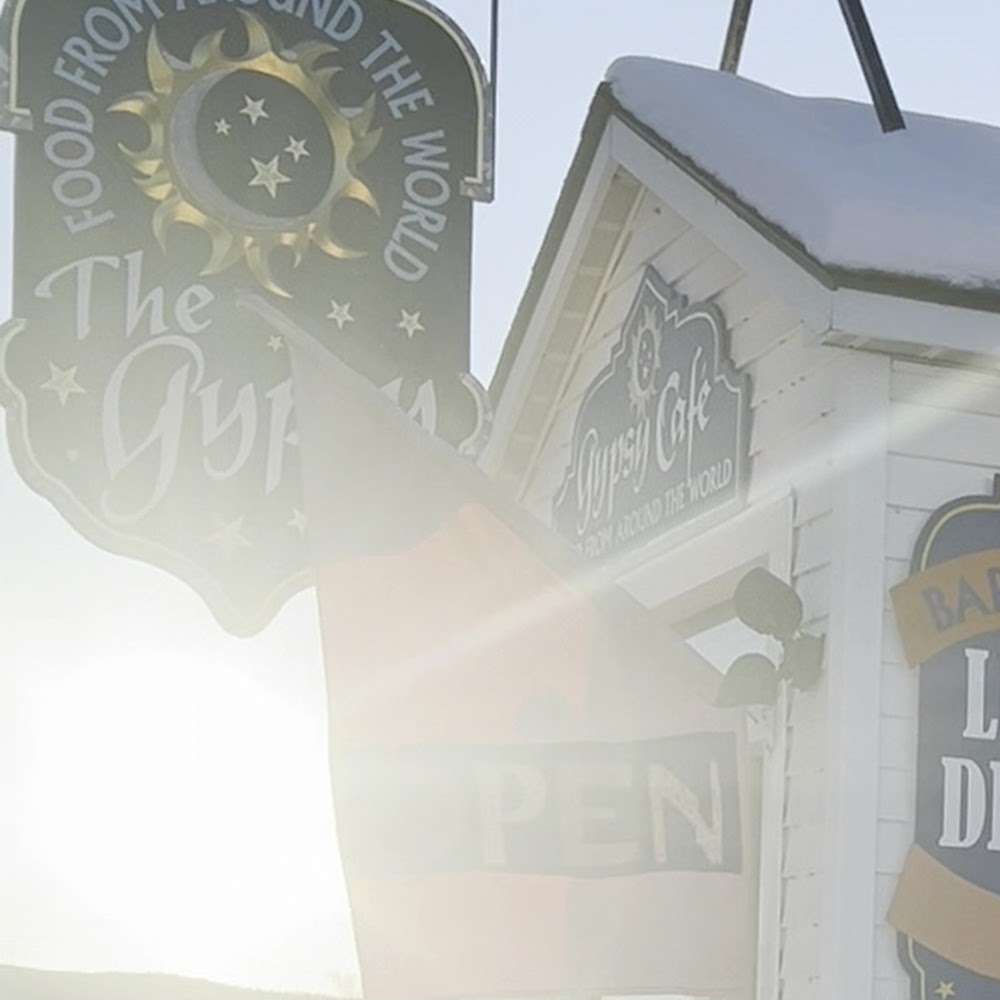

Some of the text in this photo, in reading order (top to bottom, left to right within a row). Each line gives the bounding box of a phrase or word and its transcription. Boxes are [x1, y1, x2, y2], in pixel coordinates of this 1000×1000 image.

[359, 30, 434, 119] THE
[44, 98, 115, 236] FOOD
[382, 129, 451, 282] WORLD
[34, 249, 215, 340] The
[576, 418, 650, 536] Gypsy
[665, 481, 686, 518] THE
[687, 457, 733, 502] WORLD
[372, 759, 724, 867] PEN
